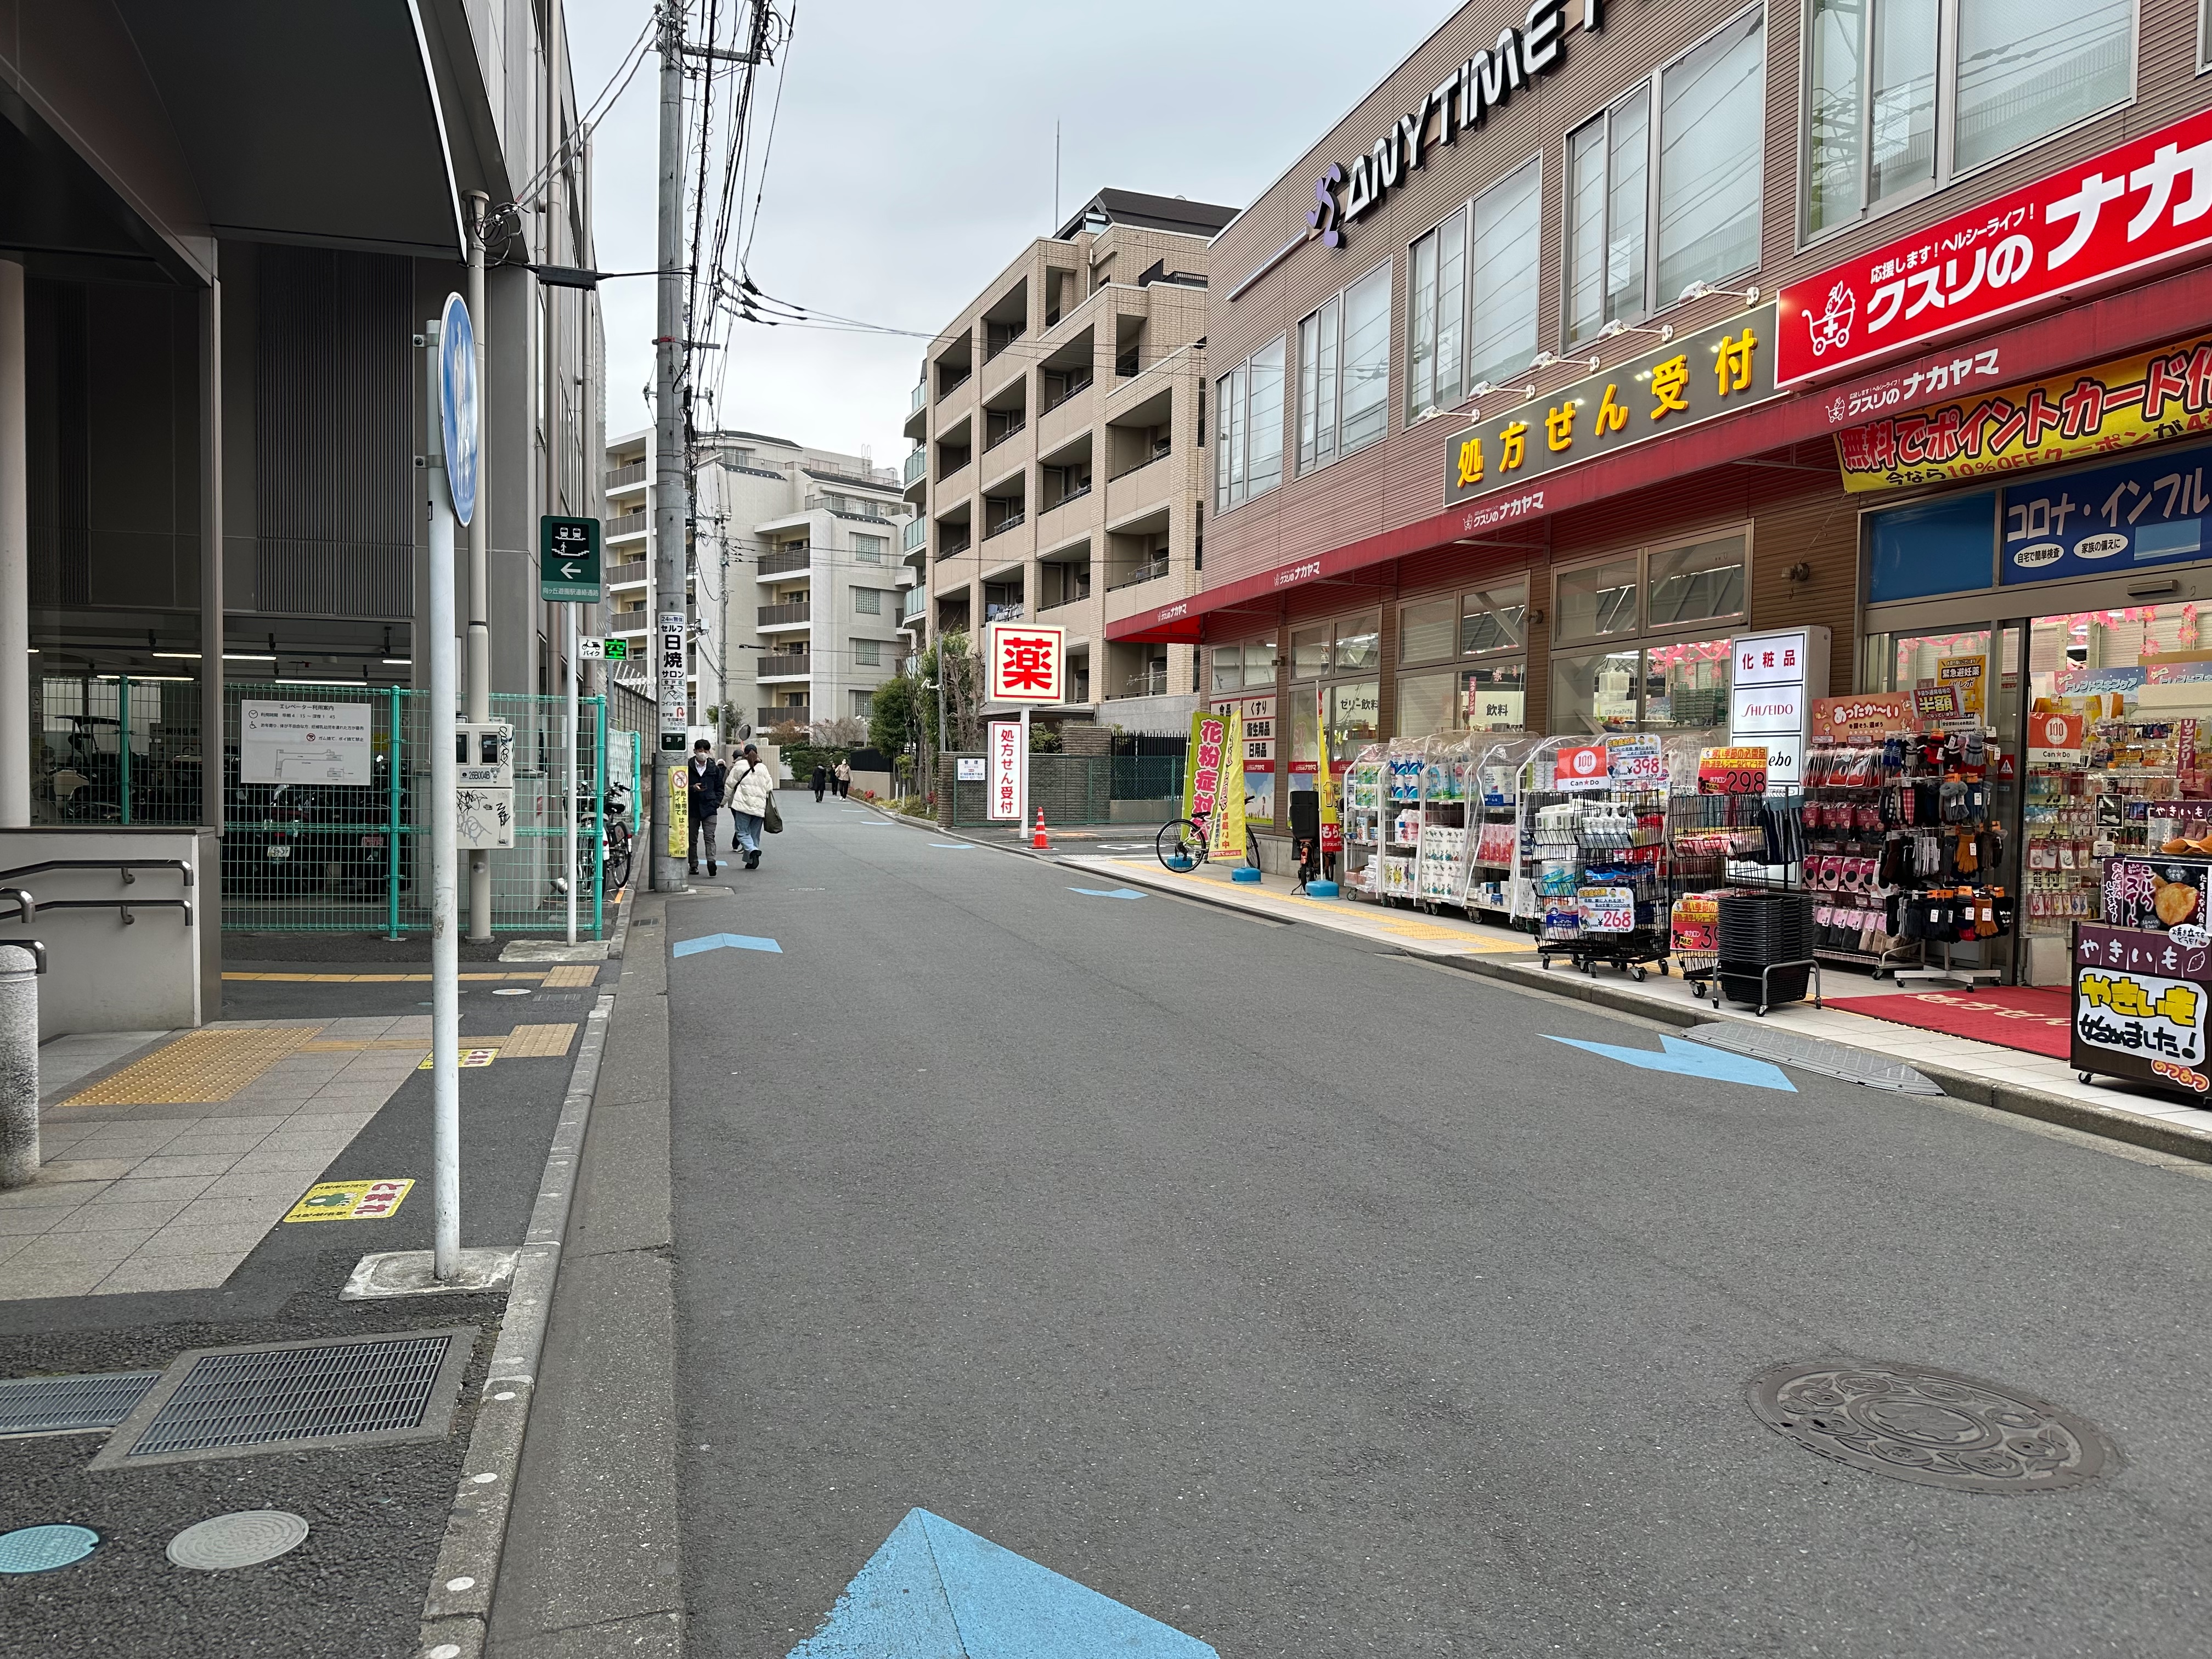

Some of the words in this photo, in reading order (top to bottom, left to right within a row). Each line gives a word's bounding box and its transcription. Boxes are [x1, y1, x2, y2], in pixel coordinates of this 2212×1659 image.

[1848, 348, 1999, 416] クスリのナカヤマ
[1457, 328, 1758, 488] 処方せん受付
[1474, 492, 1544, 528] クスリのナカヤマ
[2007, 467, 2210, 543] コロナ・インフル
[2017, 547, 2059, 563] 自宅で簡単検査
[2081, 539, 2120, 553] 家族の備えに
[605, 640, 626, 659] 空
[1002, 637, 1053, 690] 薬
[1742, 649, 1795, 670] 化粧品
[662, 670, 684, 678] サロン
[2064, 678, 2138, 693] トレンドスキンケア
[1219, 703, 1231, 717] 食品
[1251, 700, 1267, 716] くすり
[1486, 703, 1508, 716] 飲料
[1741, 704, 1793, 717] SHISEIDO
[1918, 694, 1954, 713] 半額
[1246, 721, 1270, 737] 衛生用品
[2049, 723, 2063, 736] 100
[1249, 742, 1267, 758] 日用品
[2181, 719, 2194, 770] リップクリー
[1577, 755, 1592, 768] 100
[1769, 751, 1791, 766] ebo
[1000, 729, 1014, 815] 処方せん受付
[1726, 771, 1766, 793] 298
[2155, 805, 2203, 817] やきいも
[2142, 866, 2156, 911] シルク
[2125, 877, 2140, 928] スイート
[2080, 938, 2177, 970] やきいも
[2079, 973, 2199, 1028] やきいも
[2153, 1060, 2209, 1091] あつあつ
